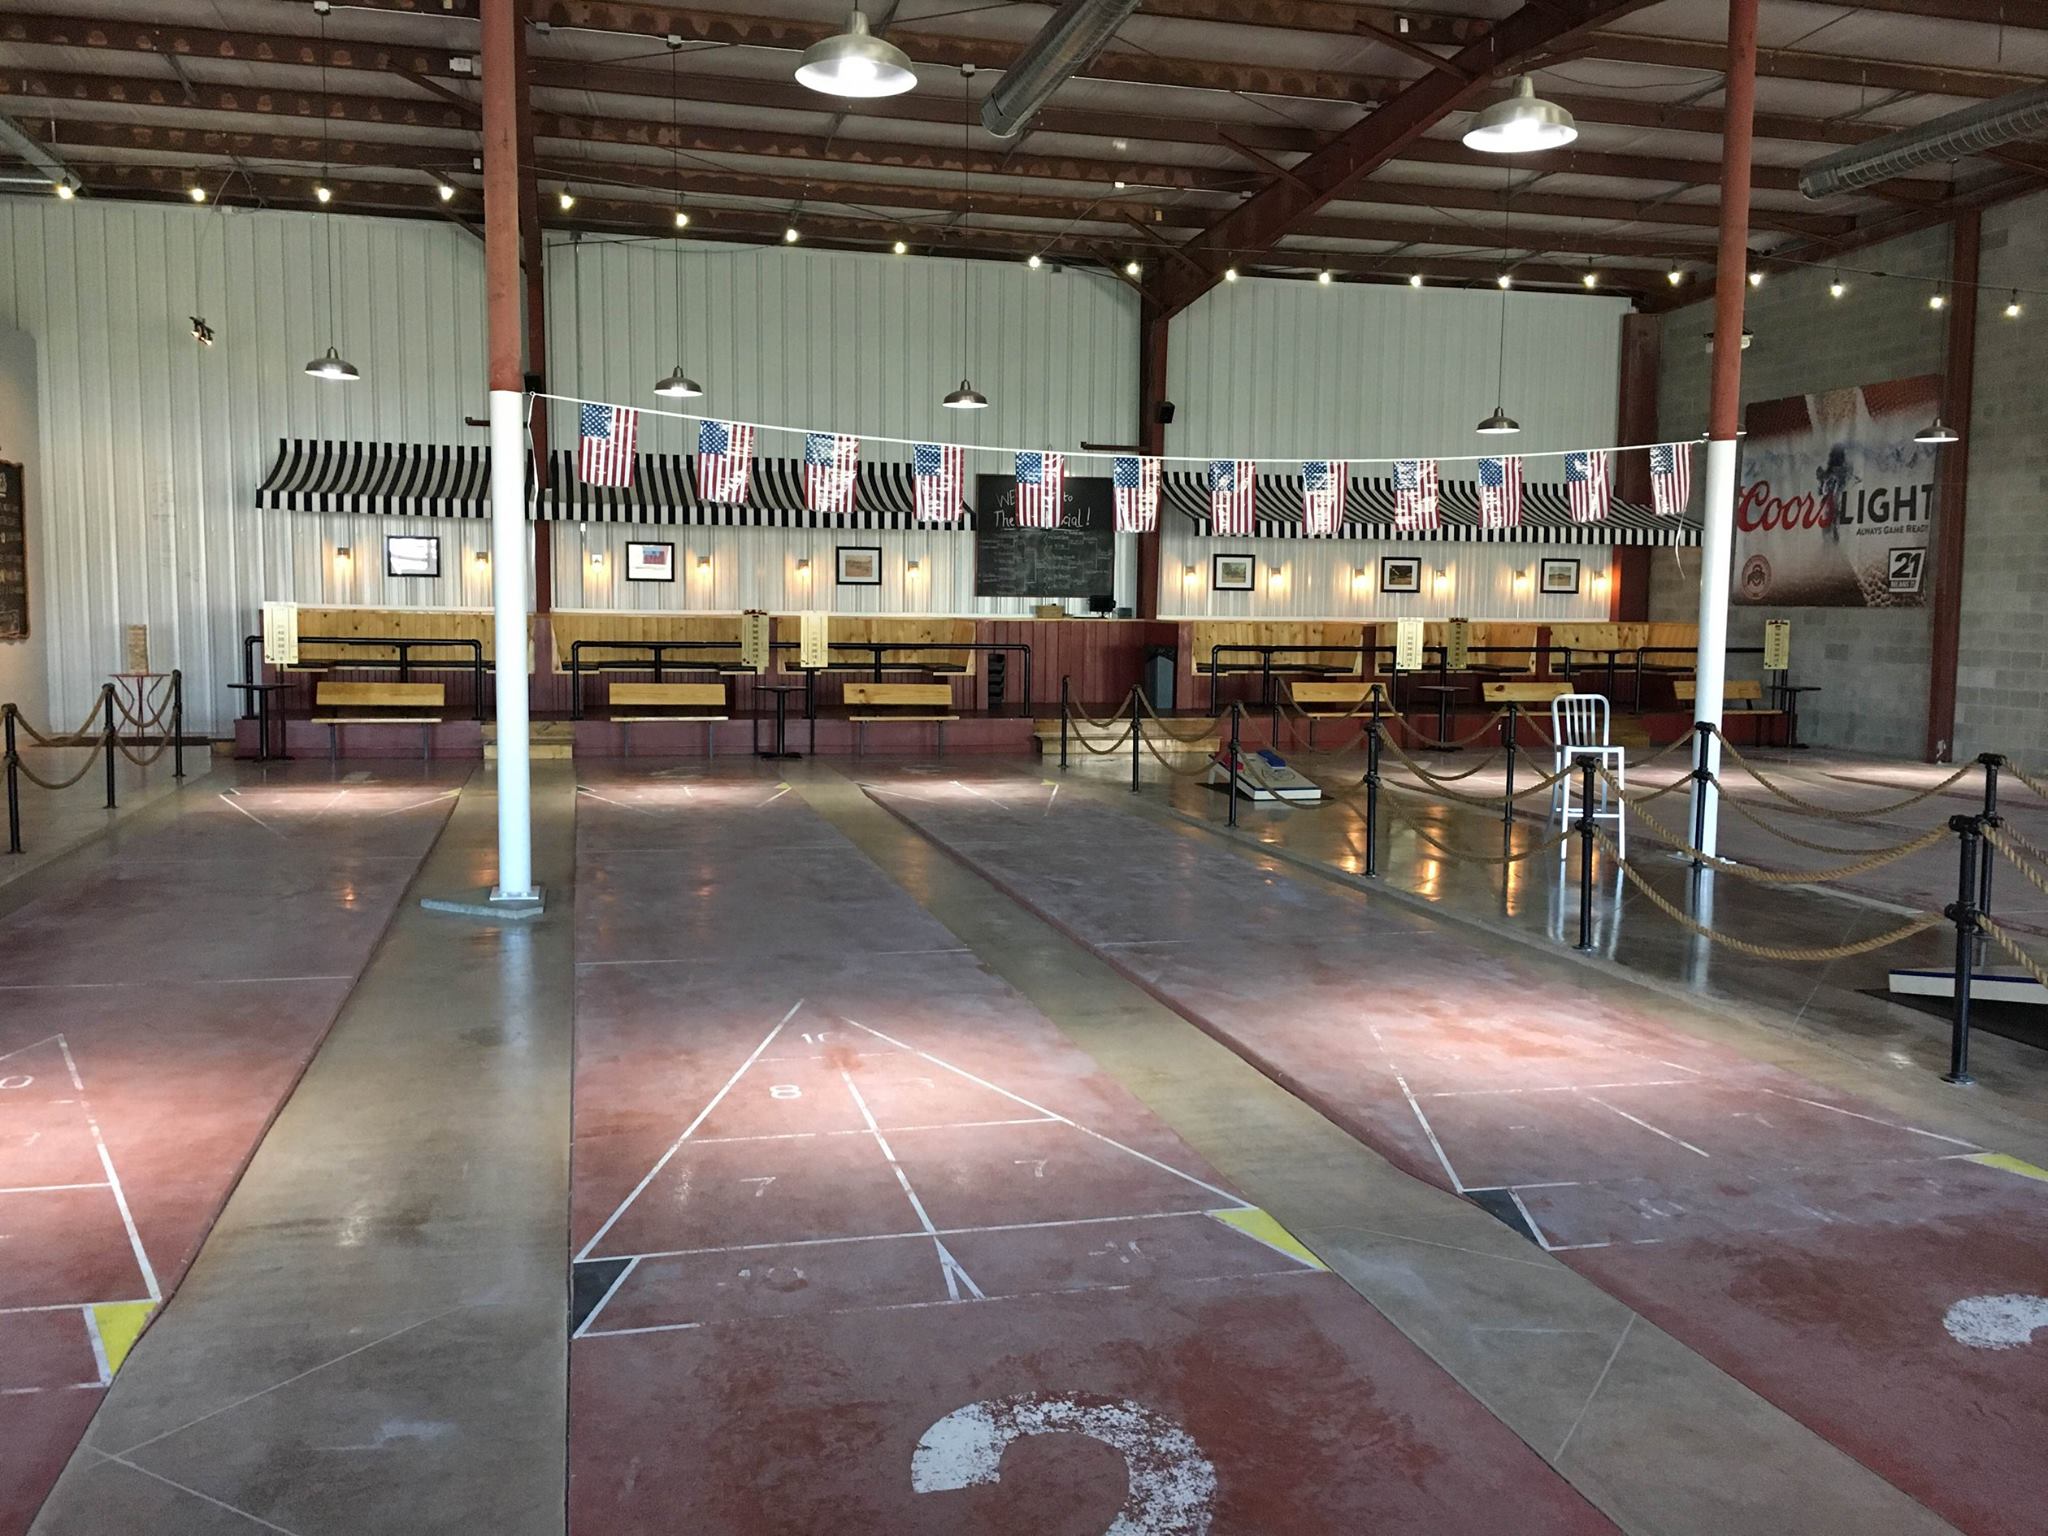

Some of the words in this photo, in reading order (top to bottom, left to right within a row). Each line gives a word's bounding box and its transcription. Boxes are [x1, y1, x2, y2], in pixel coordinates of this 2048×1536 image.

[1737, 481, 1835, 532] Coors
[1840, 483, 1935, 525] LIGHT
[994, 510, 1015, 527] The
[1884, 525, 1905, 534] GAME
[1891, 552, 1922, 579] 21
[768, 1083, 803, 1100] 8
